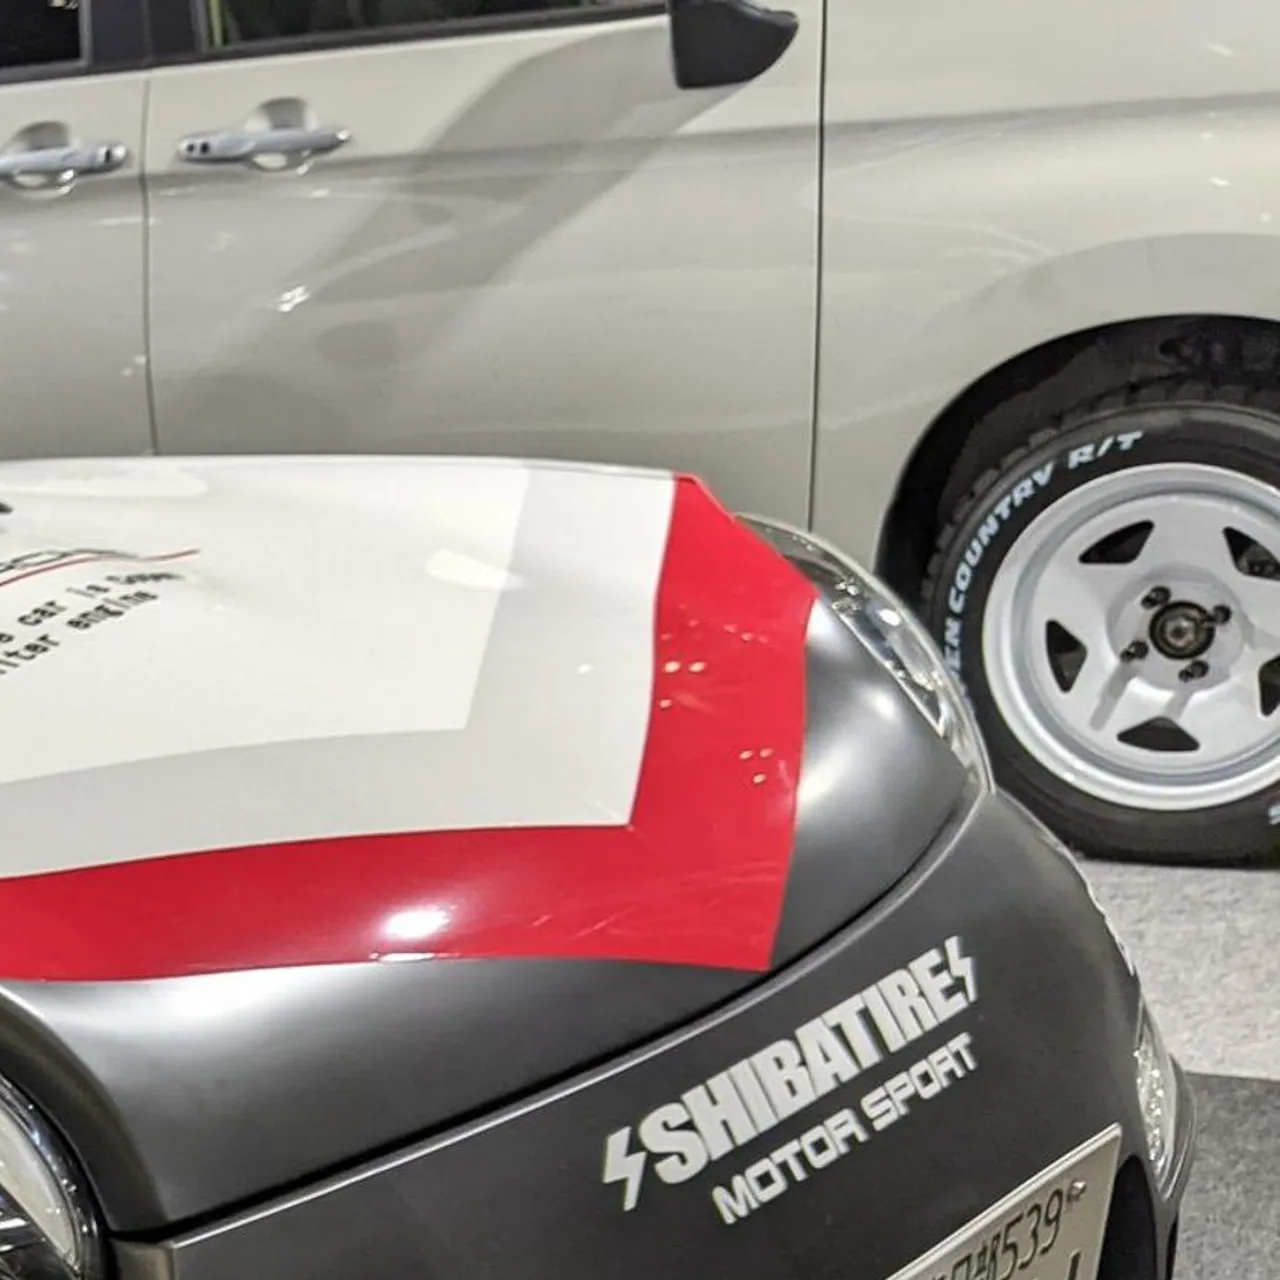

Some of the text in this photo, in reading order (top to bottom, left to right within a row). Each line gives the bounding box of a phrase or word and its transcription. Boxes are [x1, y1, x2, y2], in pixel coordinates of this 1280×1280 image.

[18, 600, 67, 627] car
[948, 461, 1054, 614] COUNTRY
[1067, 430, 1143, 469] R/T
[712, 1031, 978, 1225] MOTOR SPORT
